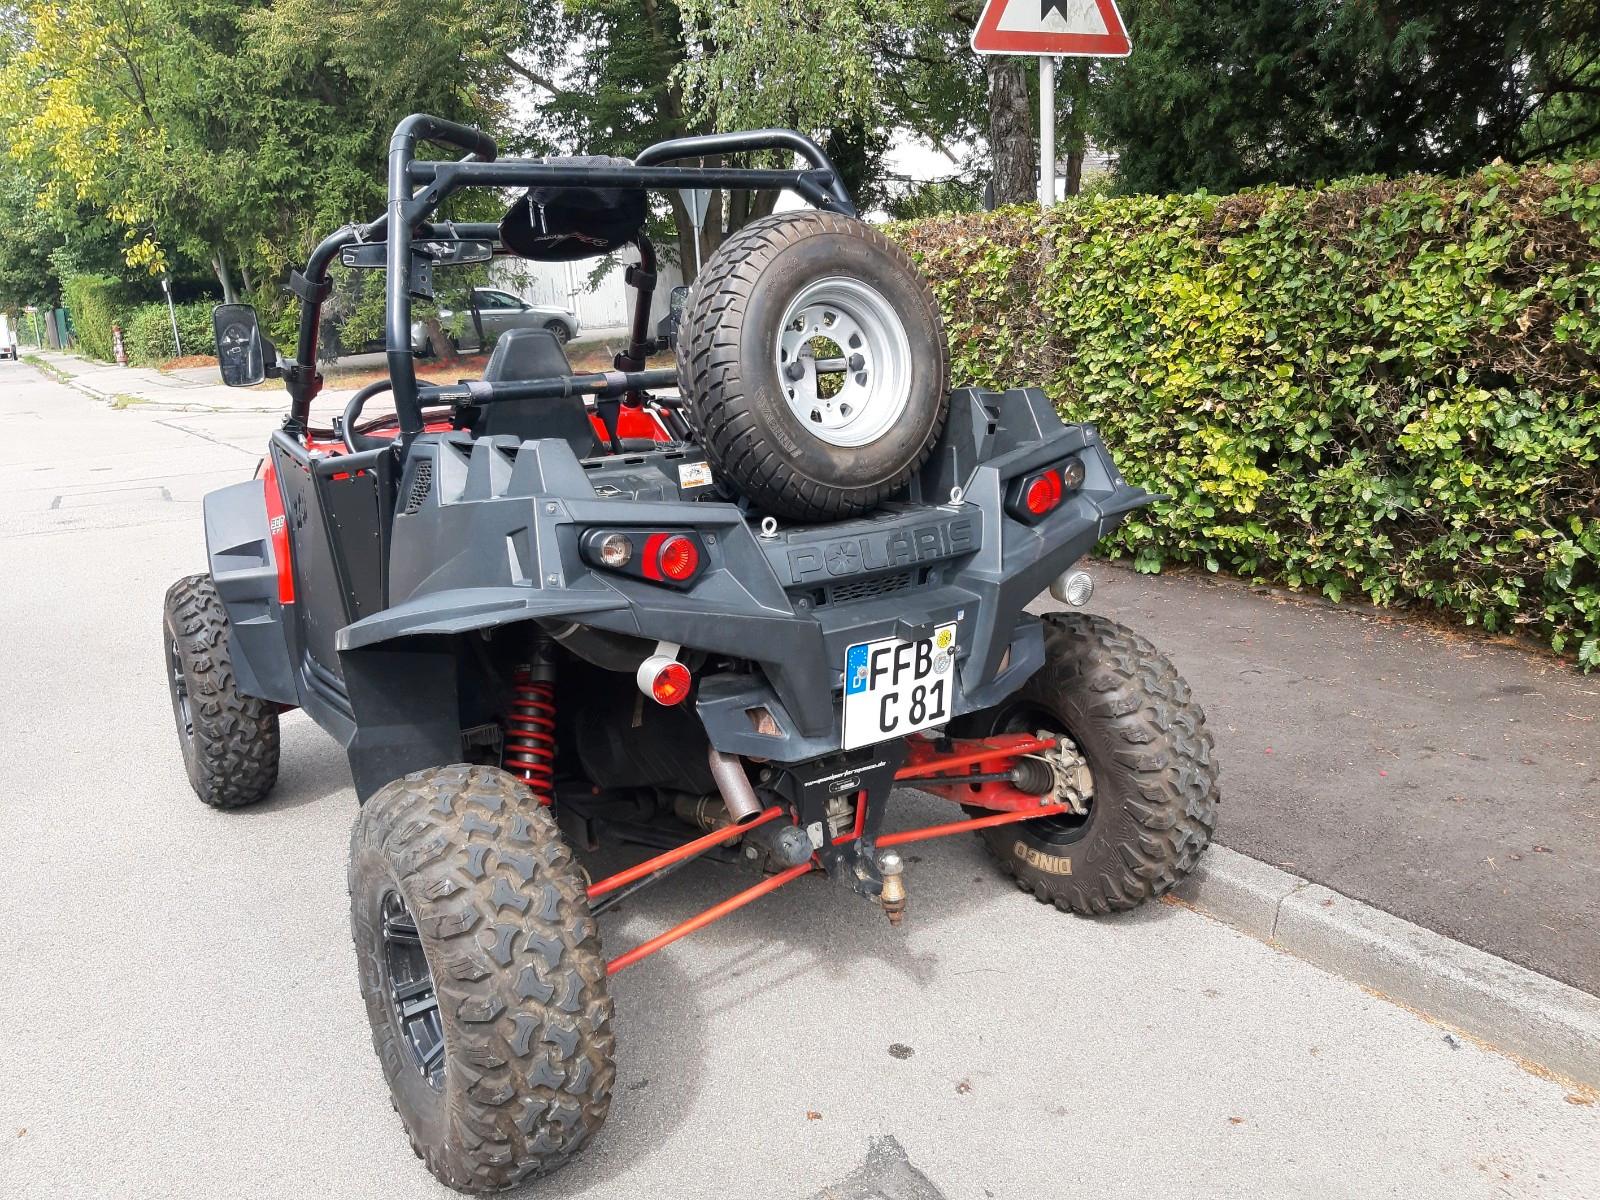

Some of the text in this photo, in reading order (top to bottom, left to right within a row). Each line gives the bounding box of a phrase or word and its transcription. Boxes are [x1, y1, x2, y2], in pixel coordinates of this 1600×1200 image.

[786, 519, 972, 583] POLARIS
[870, 638, 933, 691] FFB
[879, 679, 946, 733] C 81
[1014, 840, 1073, 876] DINGO
